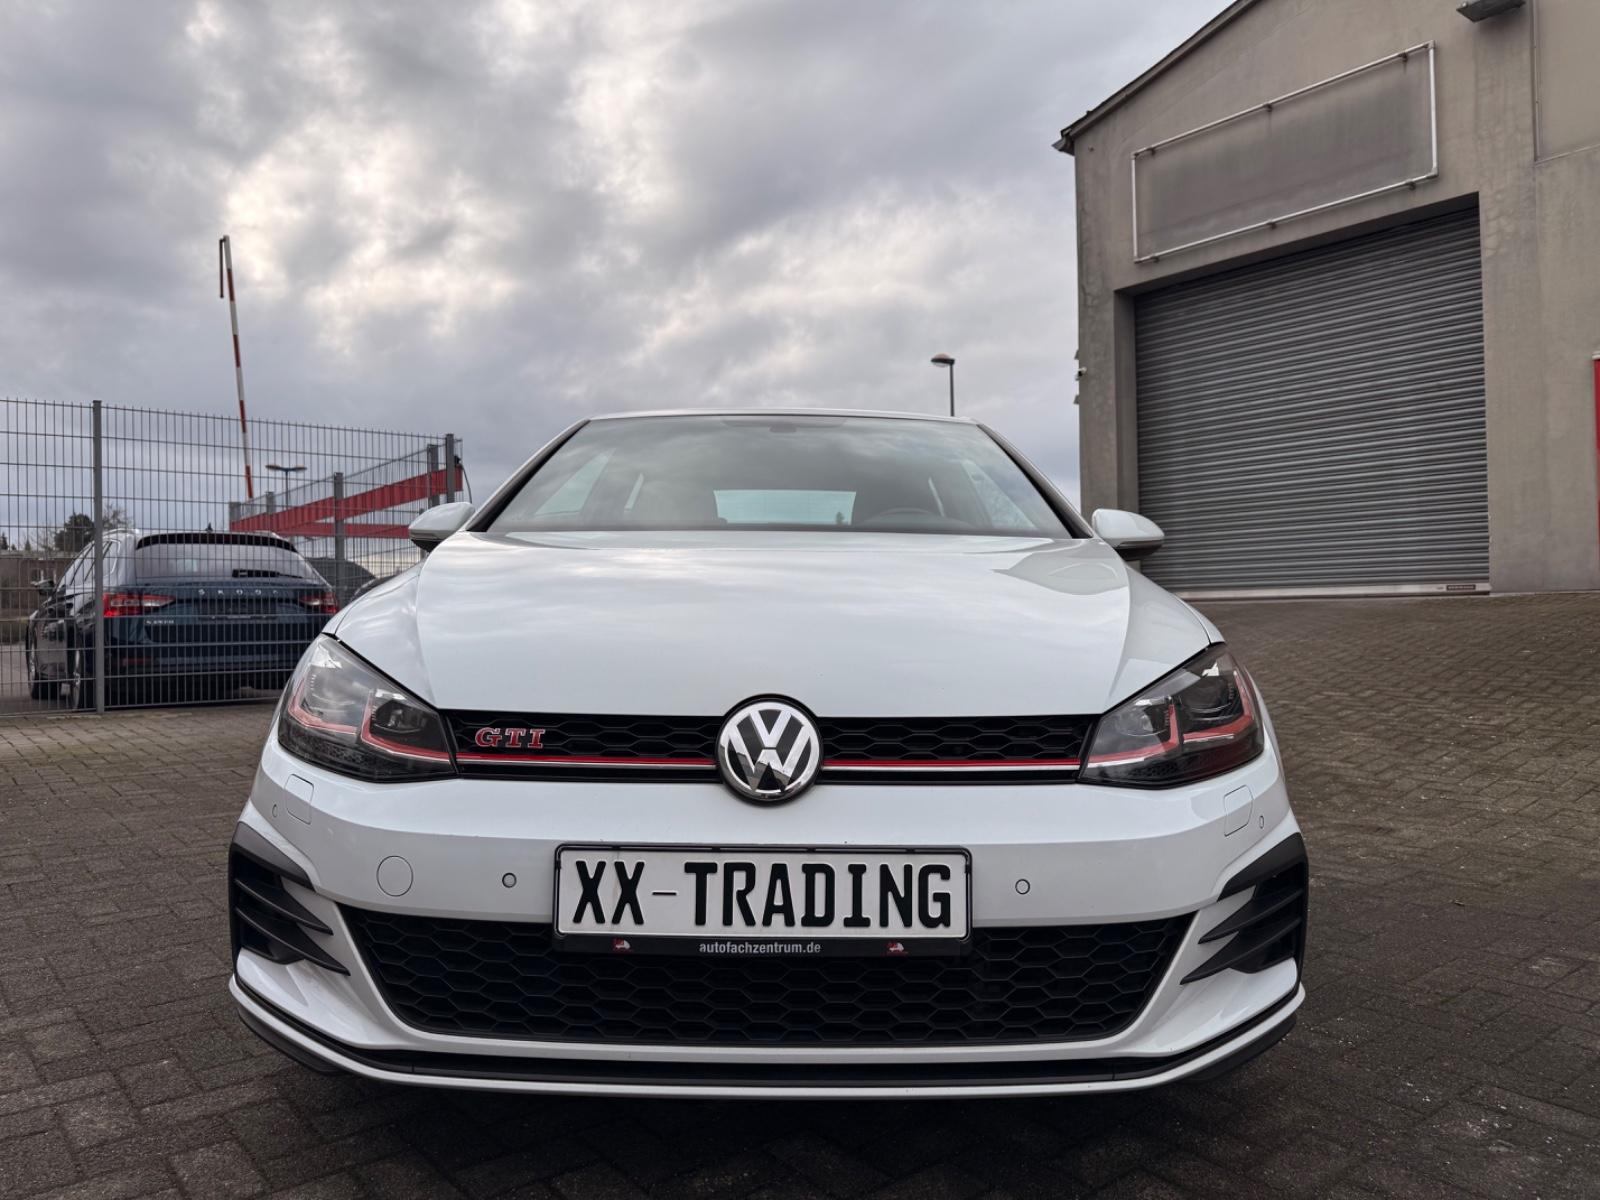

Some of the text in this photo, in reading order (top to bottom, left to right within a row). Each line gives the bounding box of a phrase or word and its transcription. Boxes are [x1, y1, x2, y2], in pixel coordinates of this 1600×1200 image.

[475, 727, 546, 748] GTI
[572, 860, 951, 929] XX-TRADING
[699, 941, 821, 954] autofachzentrum.de
